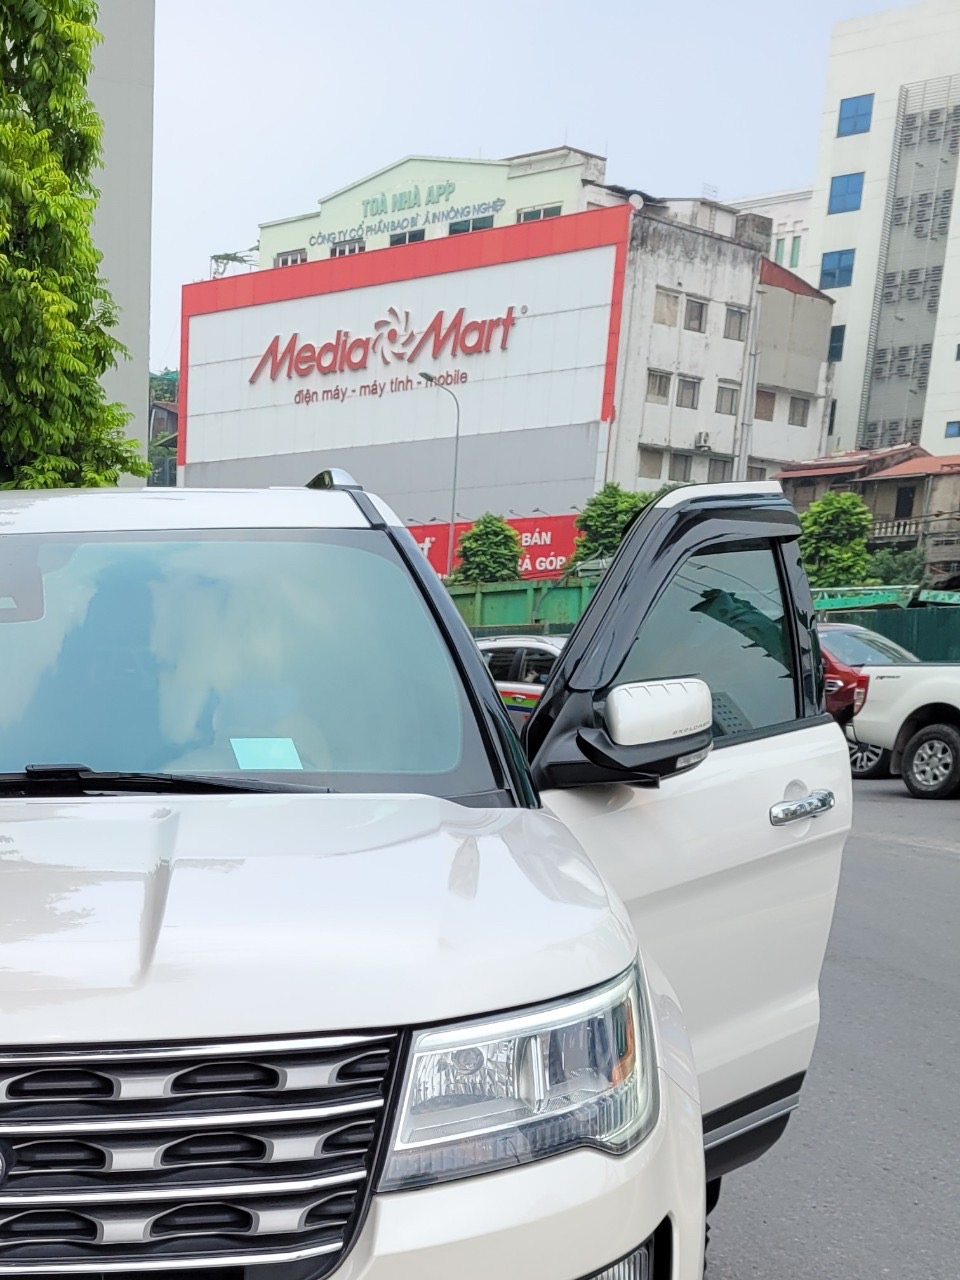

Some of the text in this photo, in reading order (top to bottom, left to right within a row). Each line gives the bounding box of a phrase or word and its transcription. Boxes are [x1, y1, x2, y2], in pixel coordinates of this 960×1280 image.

[337, 228, 349, 243] TY
[249, 305, 516, 385] Media Mart
[294, 383, 319, 406] điện
[321, 382, 348, 403] máy
[359, 378, 387, 399] máy
[390, 373, 414, 394] tính
[425, 369, 469, 388] mobile
[521, 527, 552, 547] BÁN
[535, 551, 567, 571] GÓP
